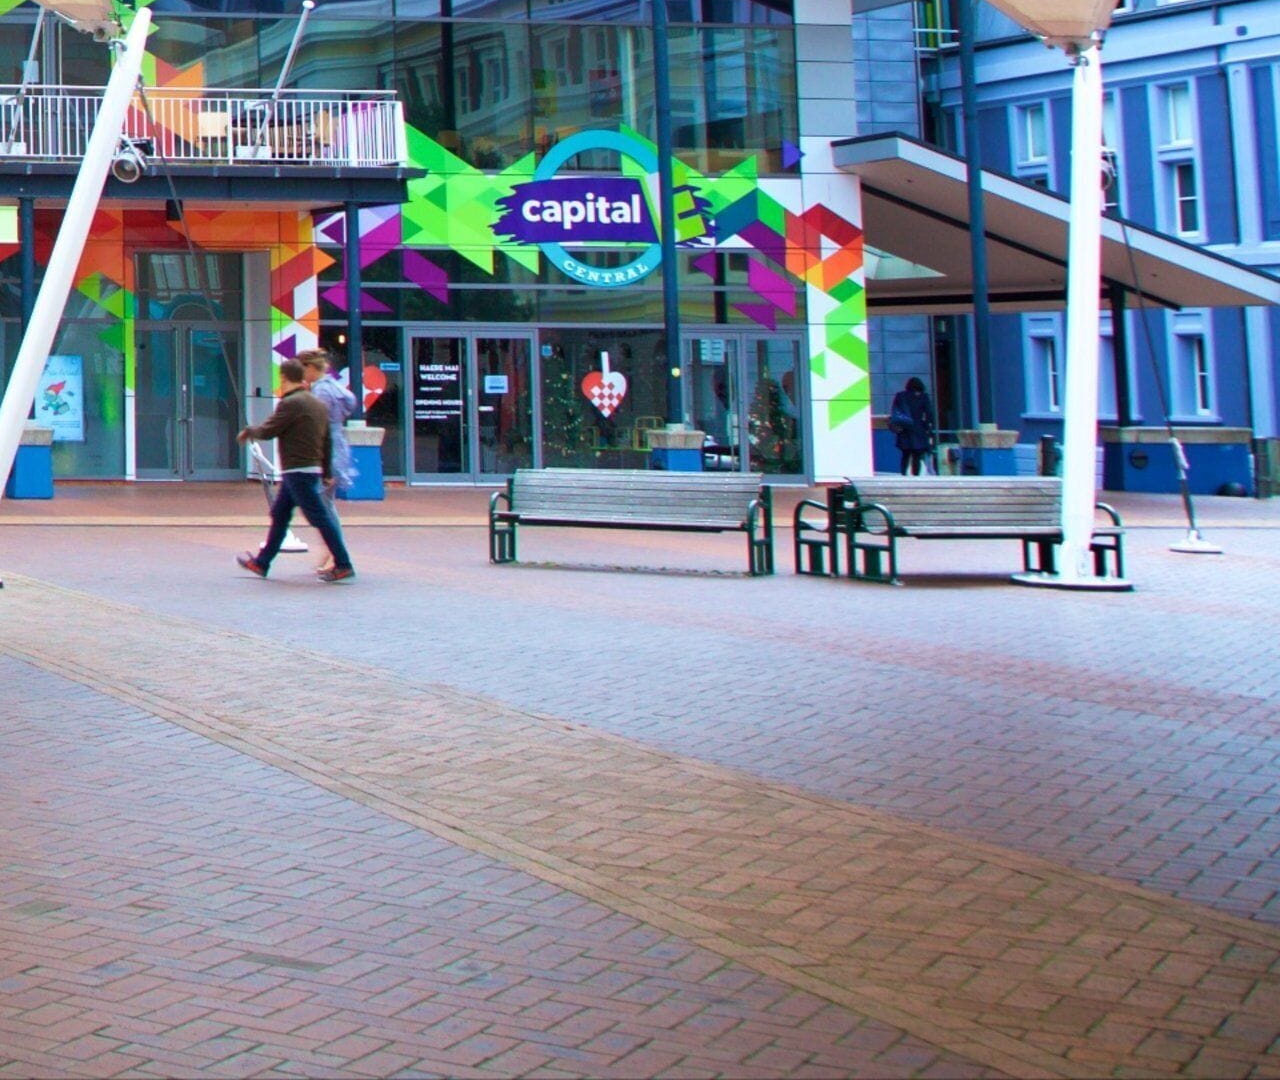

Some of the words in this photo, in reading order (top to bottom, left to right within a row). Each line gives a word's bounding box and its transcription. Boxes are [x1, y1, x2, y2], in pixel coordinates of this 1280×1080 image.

[521, 192, 641, 230] capital
[562, 259, 649, 284] CENTRAL
[420, 373, 457, 381] WELCOME
